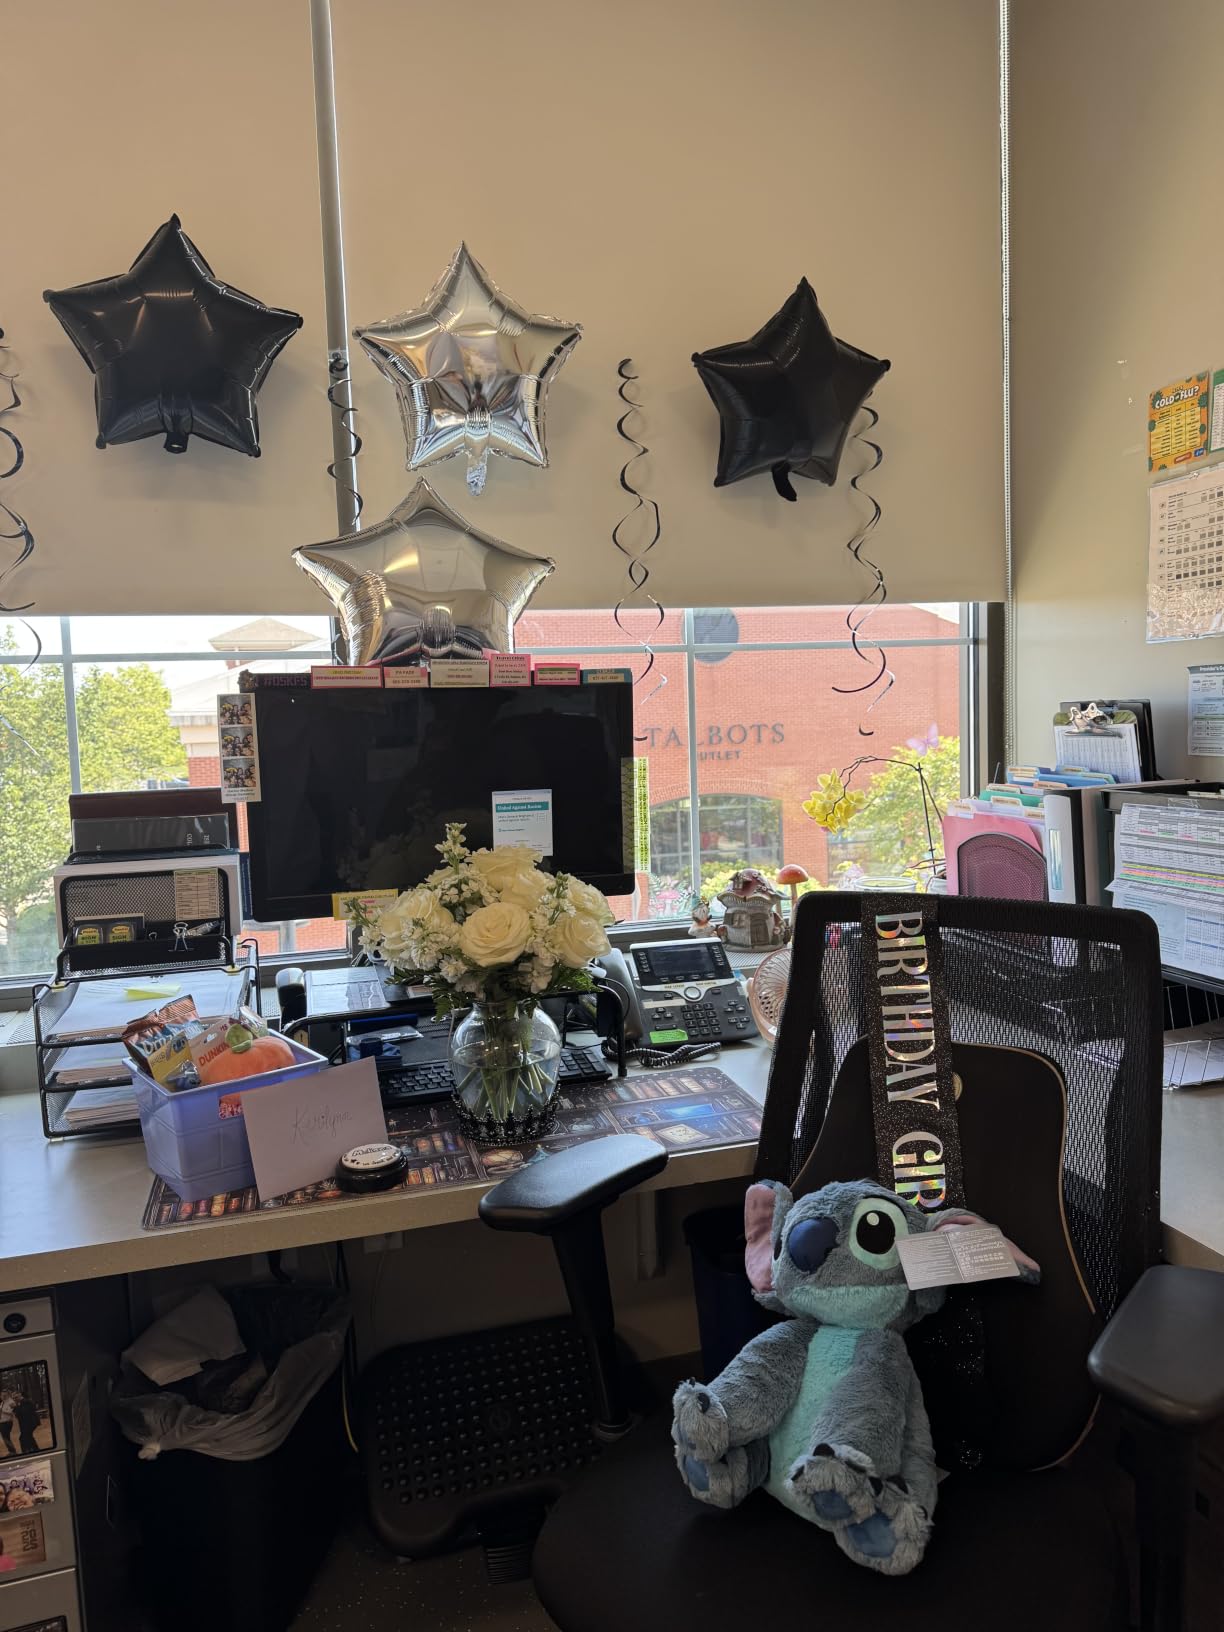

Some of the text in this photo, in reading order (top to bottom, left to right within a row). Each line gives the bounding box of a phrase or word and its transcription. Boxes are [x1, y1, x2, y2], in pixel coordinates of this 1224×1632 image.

[1155, 396, 1175, 409] COLD
[1180, 385, 1200, 401] FLU?
[699, 750, 743, 761] UTLET
[875, 910, 941, 1111] BIRTHDAY
[892, 1131, 947, 1214] GIR
